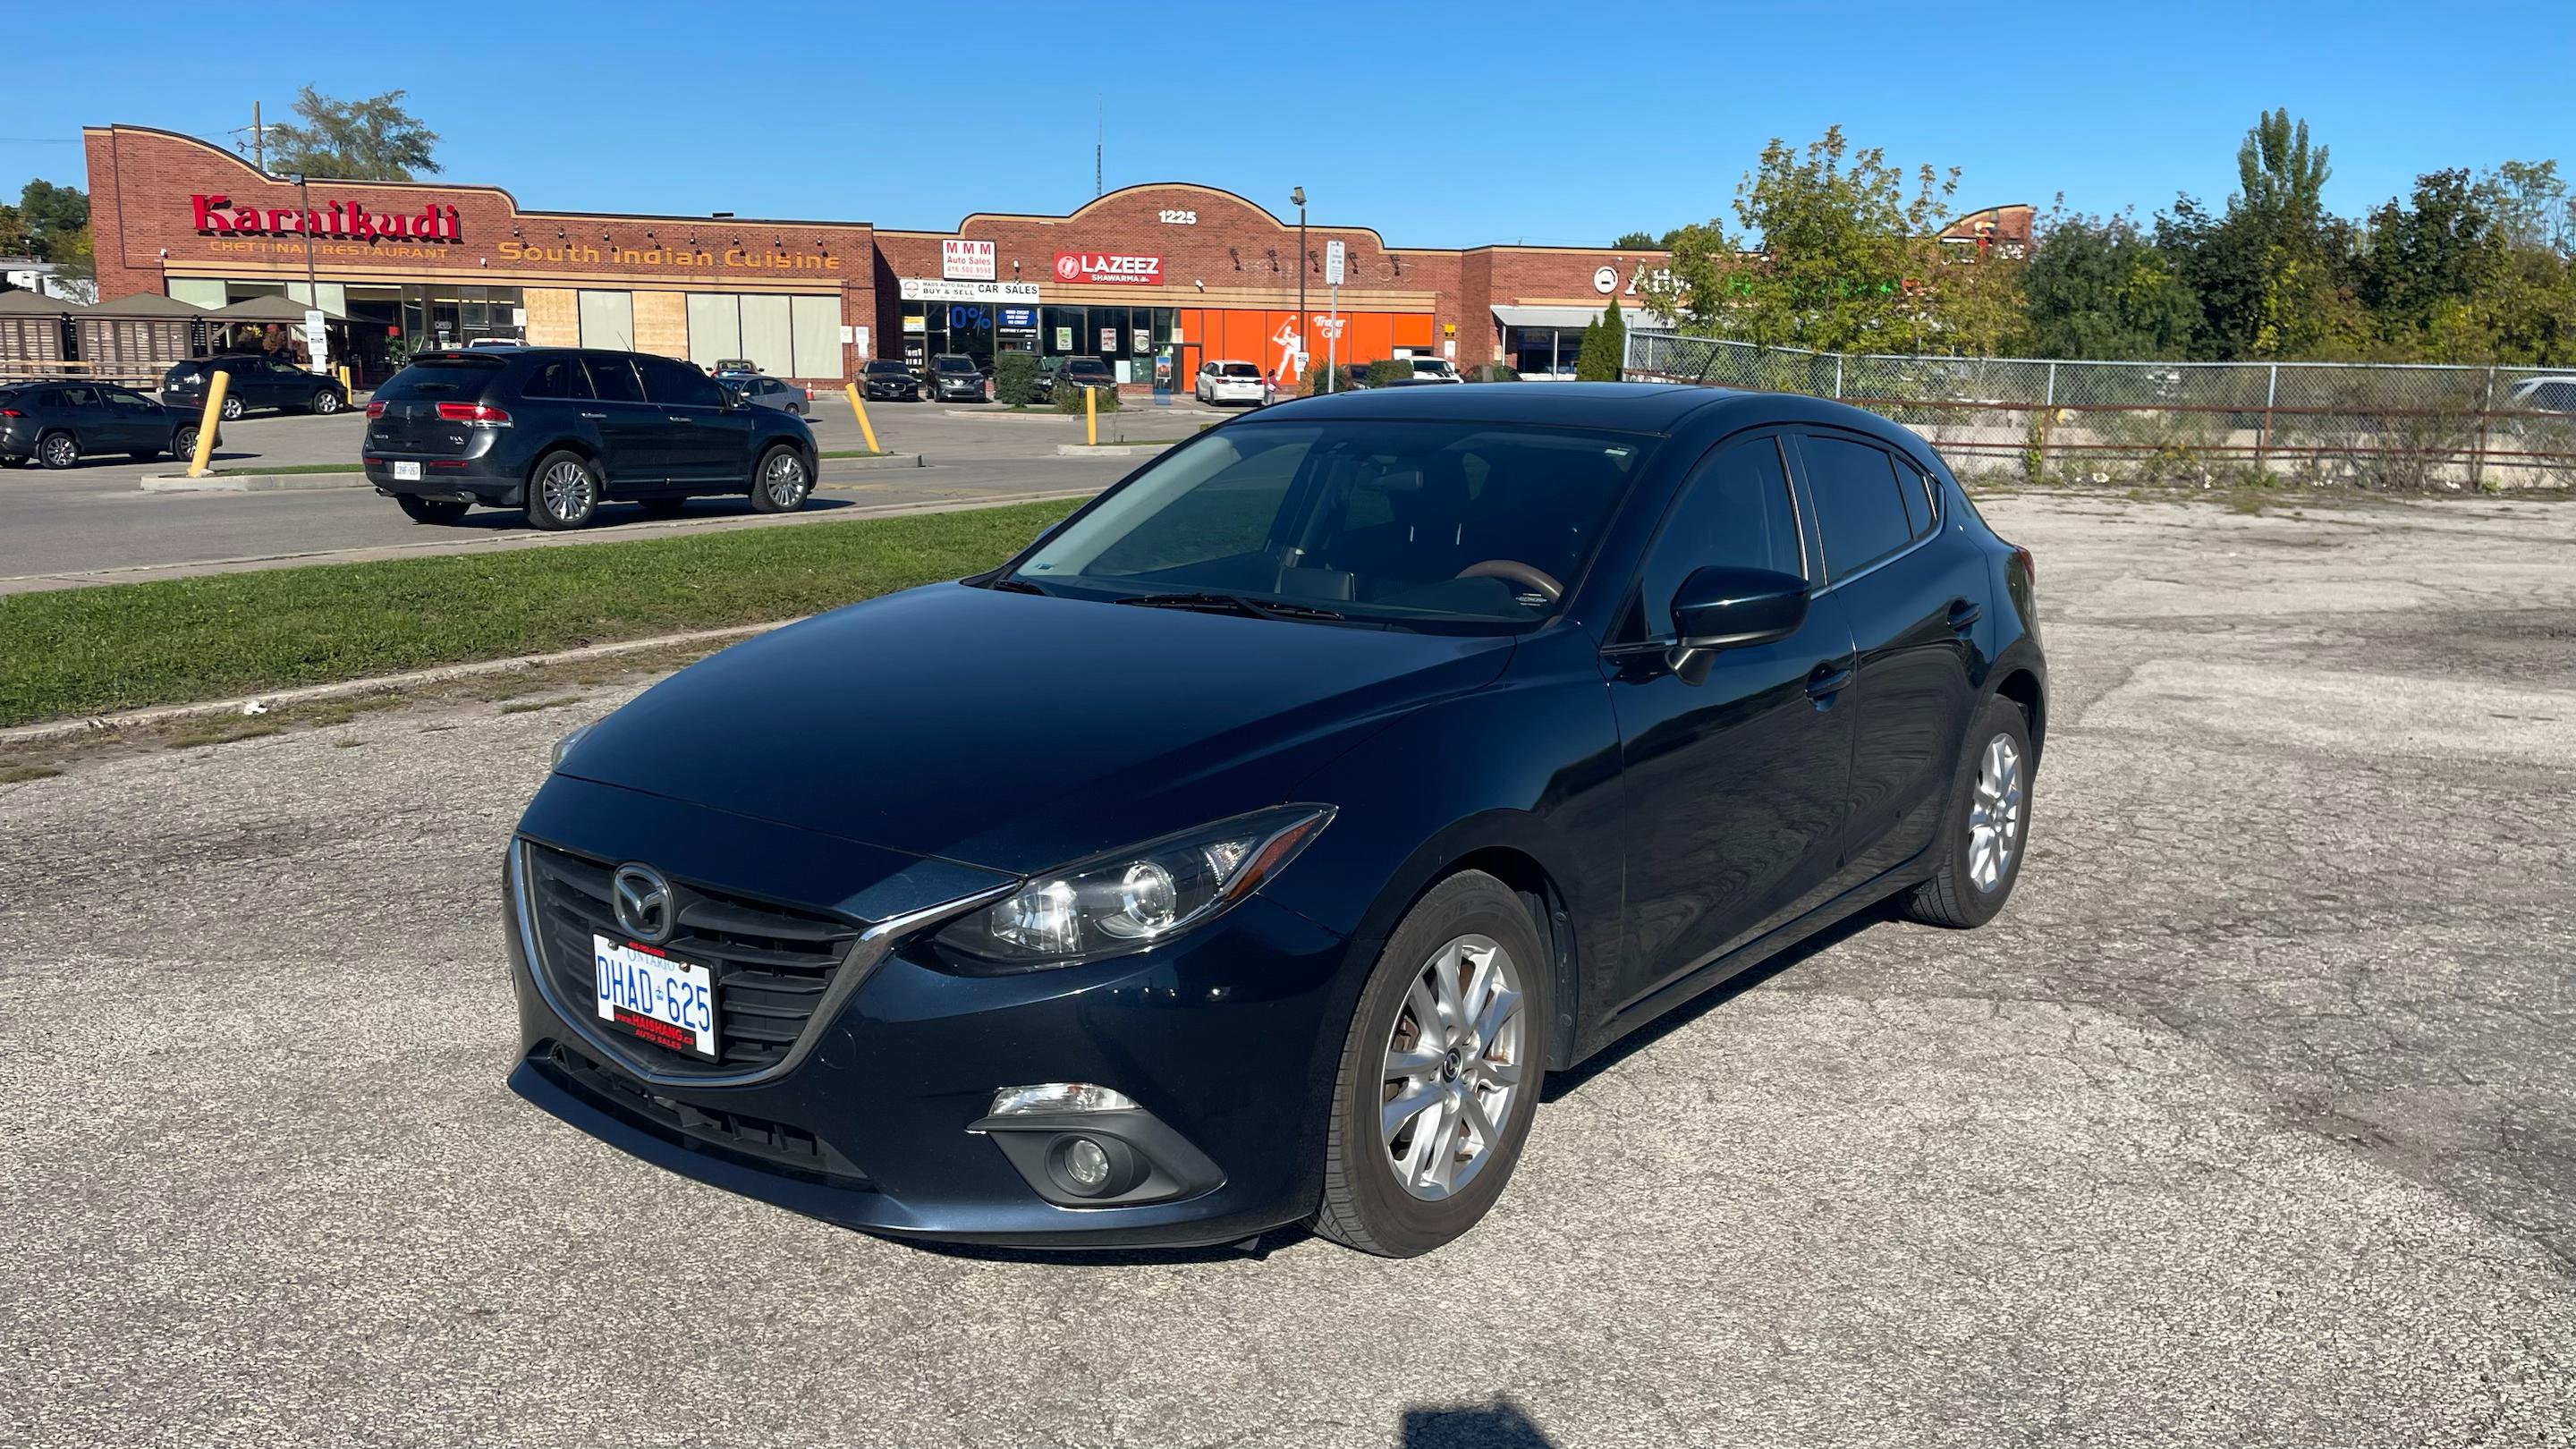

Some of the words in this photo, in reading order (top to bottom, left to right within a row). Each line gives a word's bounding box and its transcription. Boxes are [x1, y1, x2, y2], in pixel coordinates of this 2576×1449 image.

[191, 194, 462, 244] Karaikudi
[1158, 209, 1197, 225] 1225
[322, 245, 448, 259] RESTAURANT
[497, 242, 599, 264] South
[613, 247, 714, 267] Indian
[724, 249, 840, 269] Cuisine
[946, 256, 966, 265] Auto
[969, 256, 991, 266] Sales
[1081, 255, 1159, 275] LAZEEZ
[1091, 274, 1140, 283] SHAWARMA
[978, 284, 999, 293] CAR
[1005, 285, 1038, 295] SALES
[1321, 328, 1343, 339] Glf
[597, 954, 654, 1014] DHAD
[666, 977, 711, 1032] 625
[635, 1029, 657, 1041] AUTO
[657, 1036, 682, 1050] SALES
